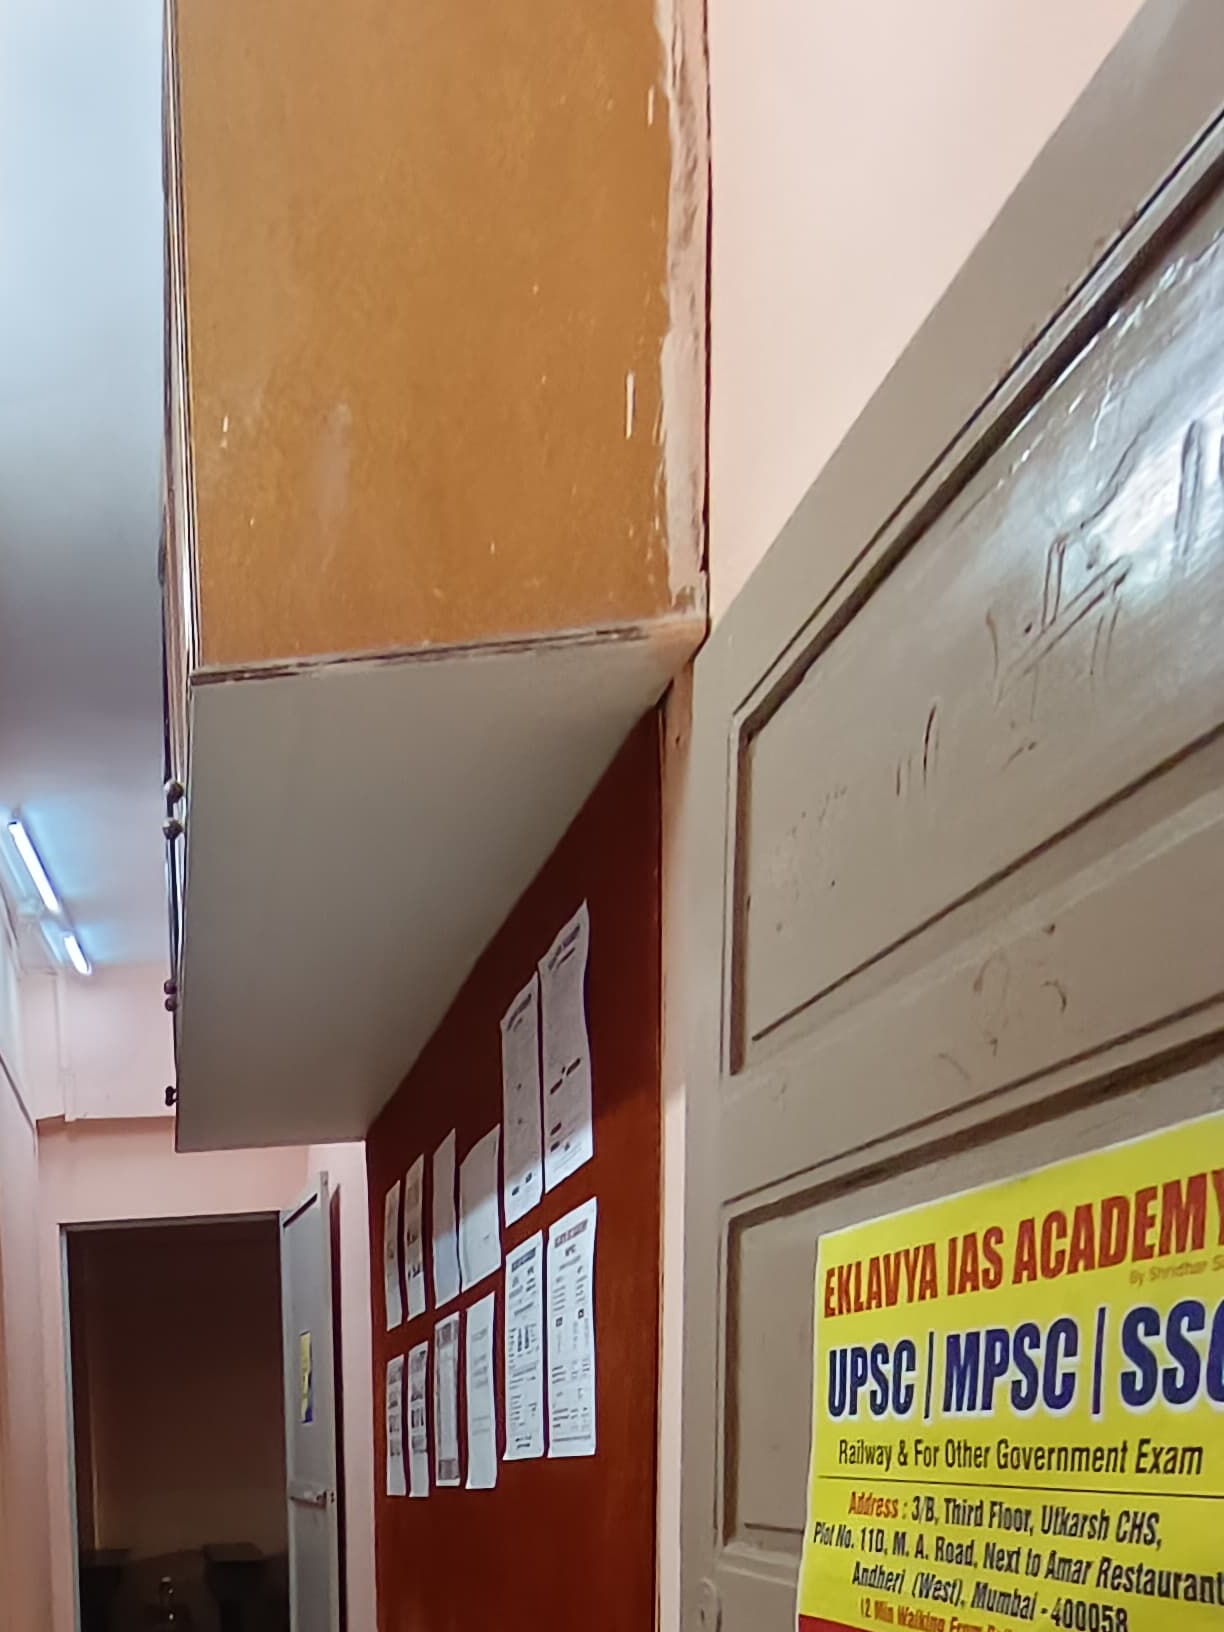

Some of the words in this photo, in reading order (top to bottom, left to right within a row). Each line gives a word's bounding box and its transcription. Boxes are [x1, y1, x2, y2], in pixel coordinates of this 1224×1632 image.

[824, 1243, 938, 1318] EKLAVYA
[947, 1226, 1004, 1296] IAS
[828, 1339, 916, 1417] UPSC
[943, 1317, 1079, 1411] MPSC
[839, 1439, 893, 1472] Railway
[897, 1442, 909, 1465] &
[914, 1439, 940, 1468] For
[945, 1439, 991, 1469] Other
[996, 1438, 1129, 1474] Government
[1135, 1438, 1204, 1475] Exam
[848, 1491, 899, 1518] Address
[943, 1498, 984, 1527] Third
[988, 1500, 1034, 1536] Floor,
[1041, 1505, 1111, 1541] Utkarsh
[1115, 1510, 1163, 1551] CHS,
[813, 1521, 836, 1546] Plot
[892, 1531, 910, 1557] M.
[914, 1533, 929, 1560] A.
[983, 1541, 1022, 1575] Next
[1024, 1548, 1042, 1578] to
[1044, 1549, 1095, 1585] Amar
[851, 1561, 906, 1594] Andheri
[970, 1581, 1038, 1621] Mumbai
